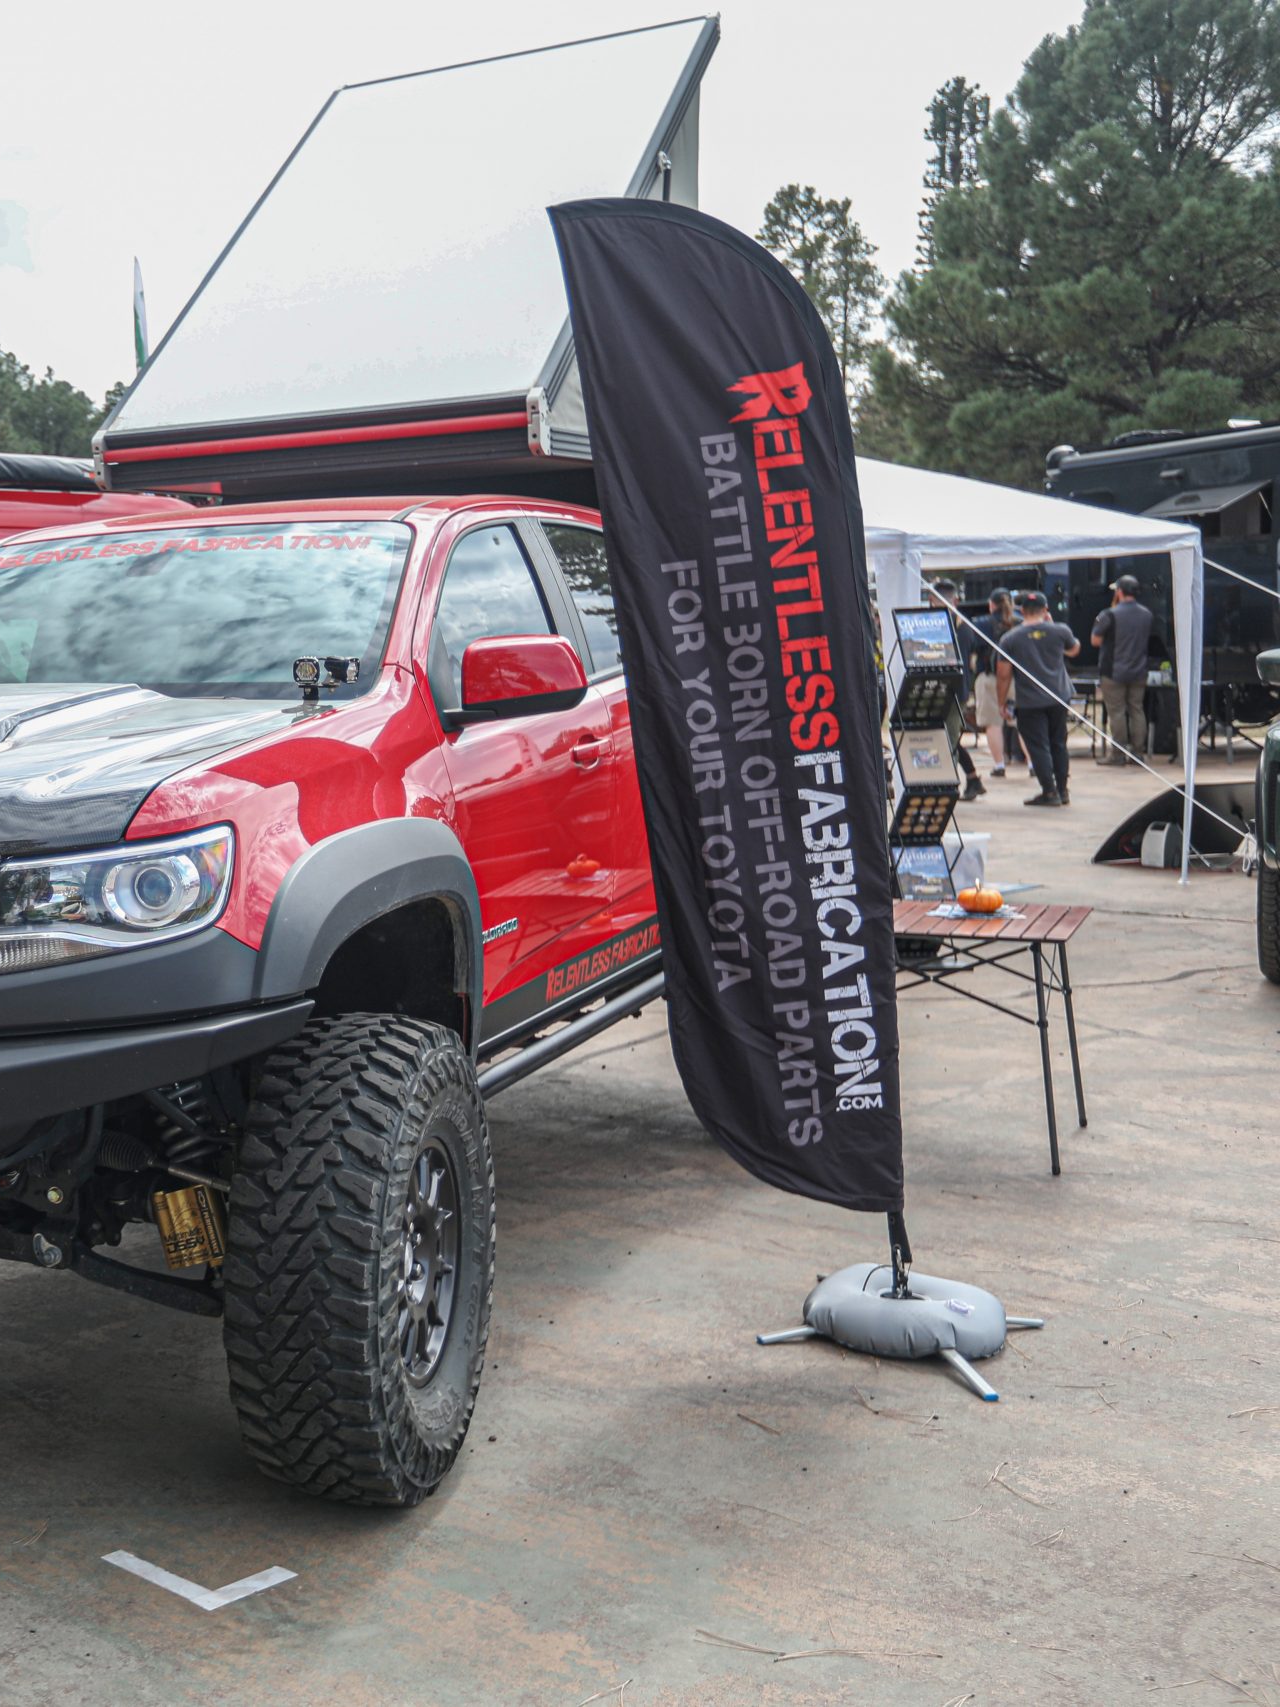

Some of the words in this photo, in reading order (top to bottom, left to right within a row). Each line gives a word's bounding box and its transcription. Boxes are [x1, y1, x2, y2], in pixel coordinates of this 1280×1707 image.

[700, 432, 759, 613] BATTLE
[725, 362, 840, 750] RELENTLESS
[660, 559, 707, 656] FOR
[680, 667, 726, 794] YOUR
[723, 622, 772, 742] BORN
[698, 804, 753, 993] TOYOTA
[740, 754, 807, 989] OFF-ROAD
[545, 948, 613, 1003] RELENTLESS
[610, 923, 660, 970] FABRICATI
[772, 999, 824, 1147] PARTS
